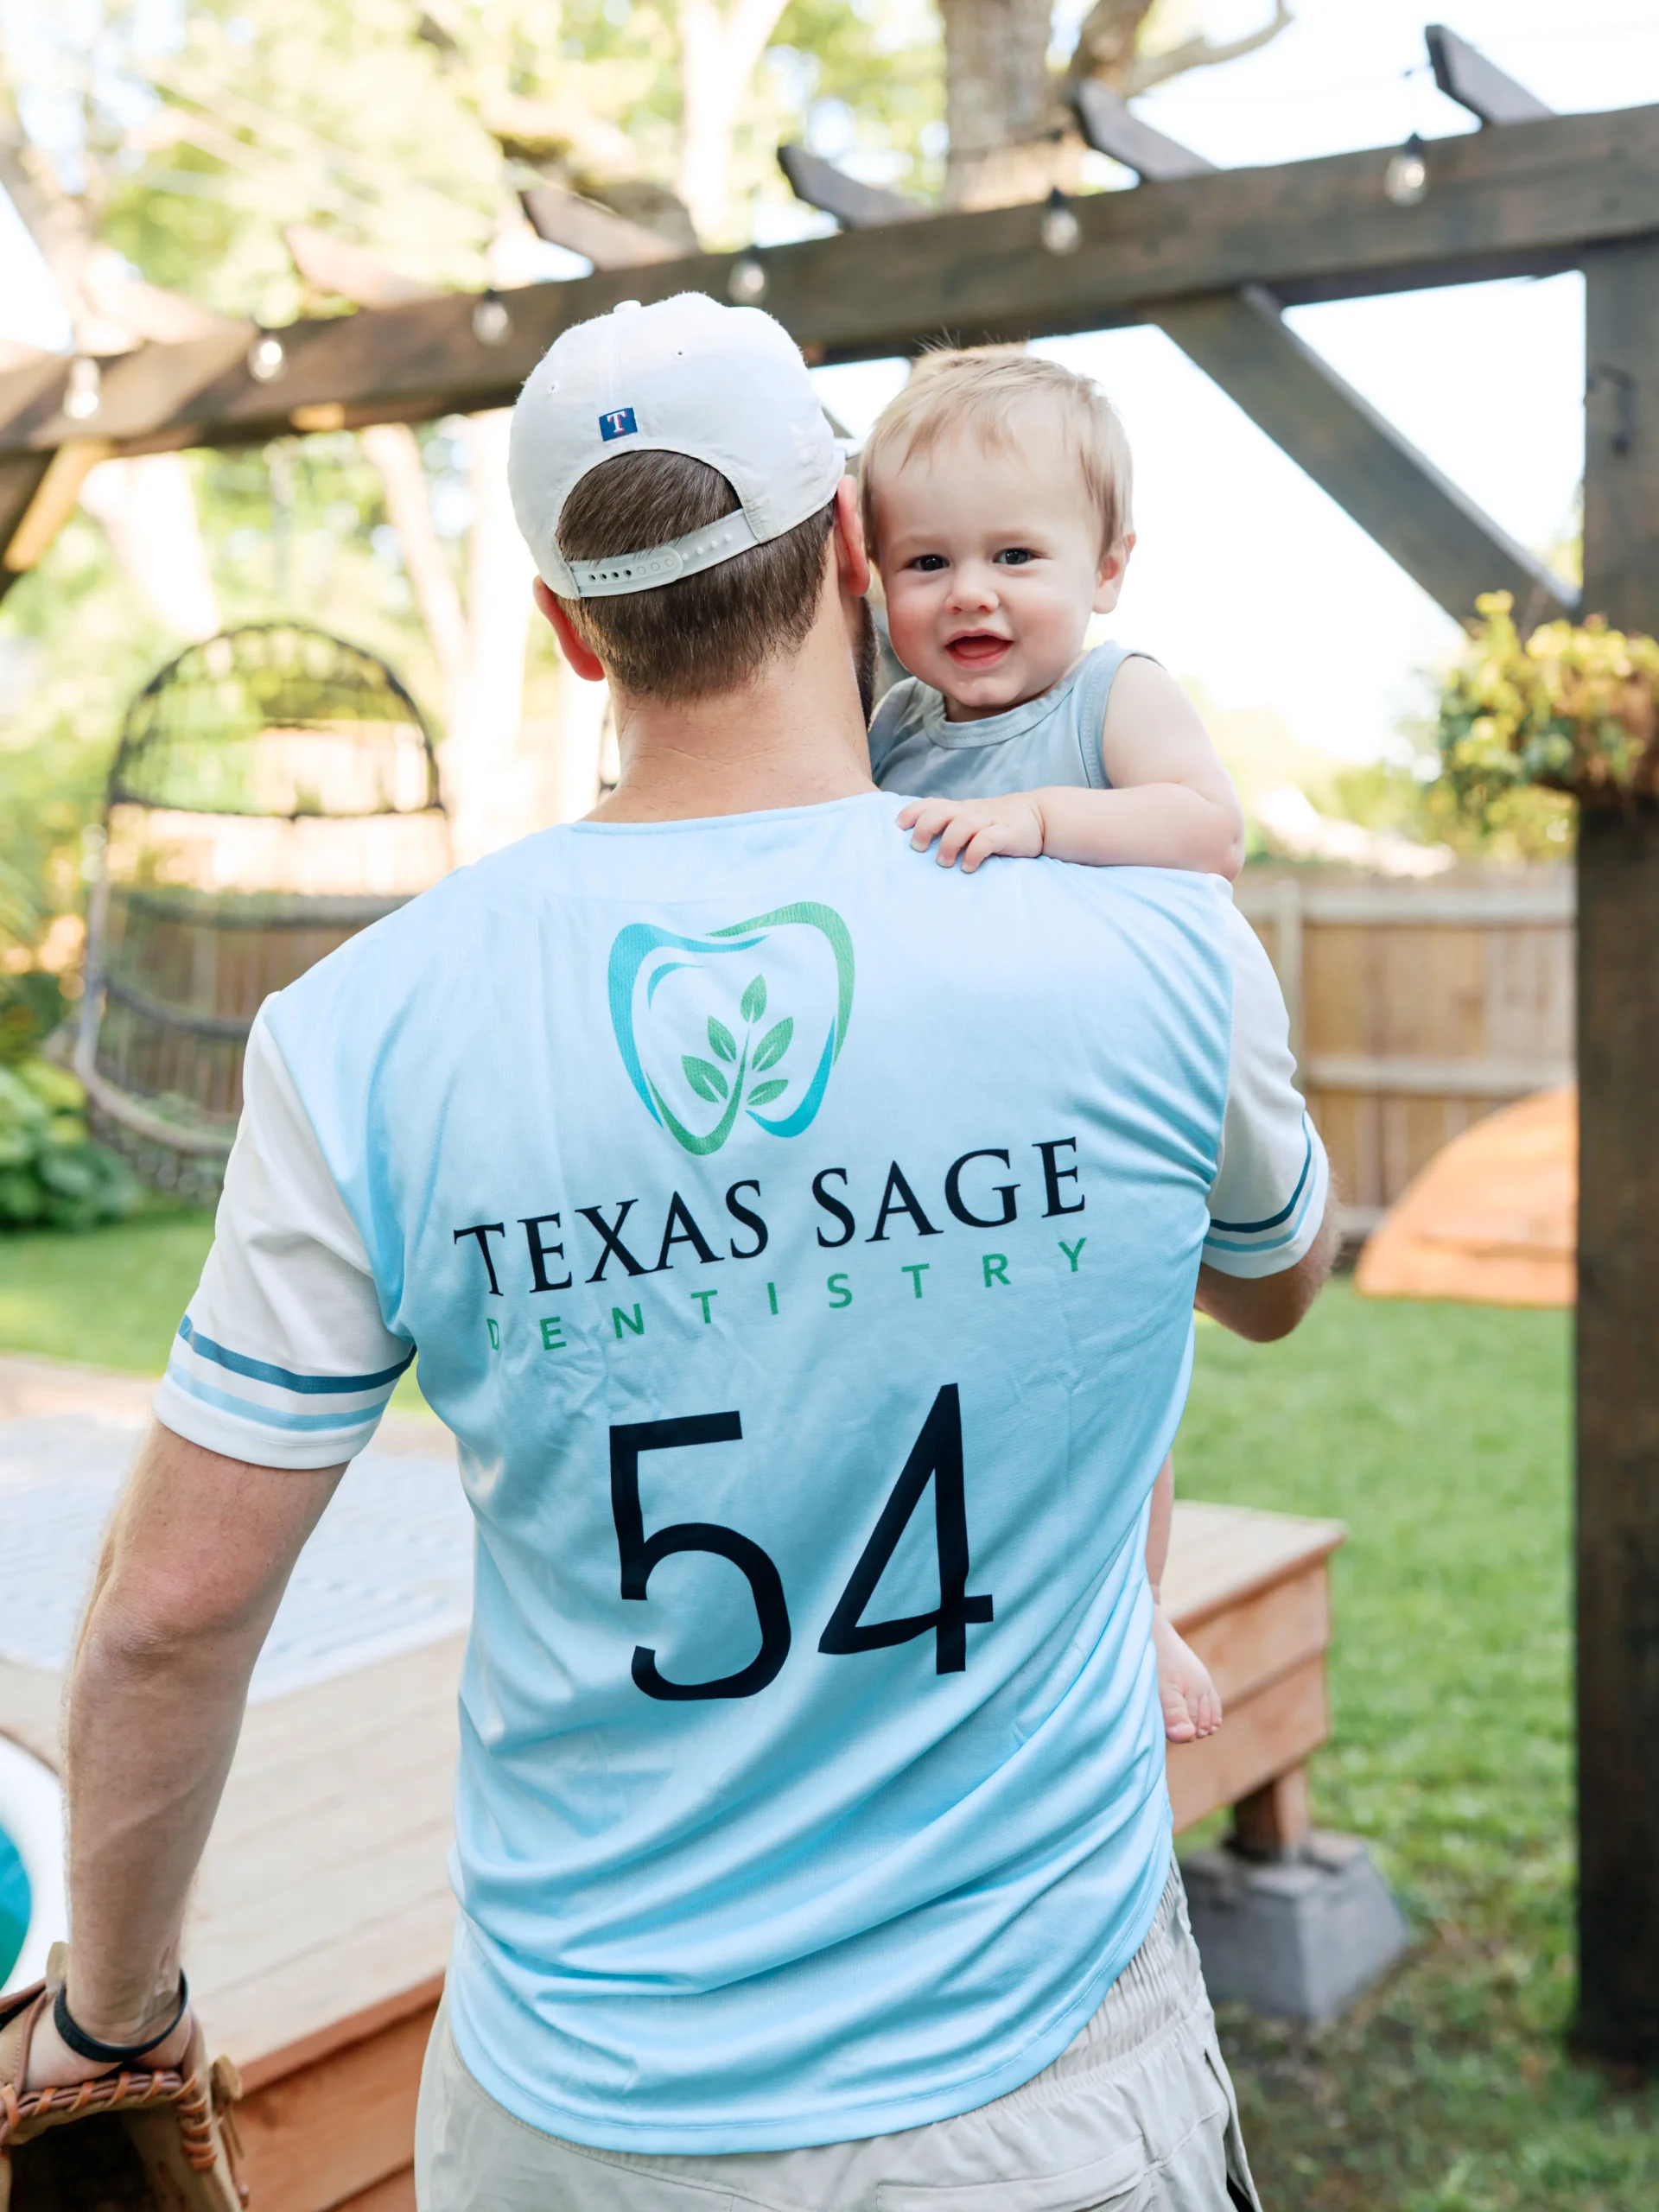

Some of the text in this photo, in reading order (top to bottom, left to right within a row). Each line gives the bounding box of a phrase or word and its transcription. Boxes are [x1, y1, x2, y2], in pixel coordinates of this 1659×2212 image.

[607, 410, 627, 435] T
[454, 1136, 1087, 1297] TEXAS SAGE
[487, 1237, 1088, 1351] DENTISTRY
[609, 1382, 994, 1700] 54
